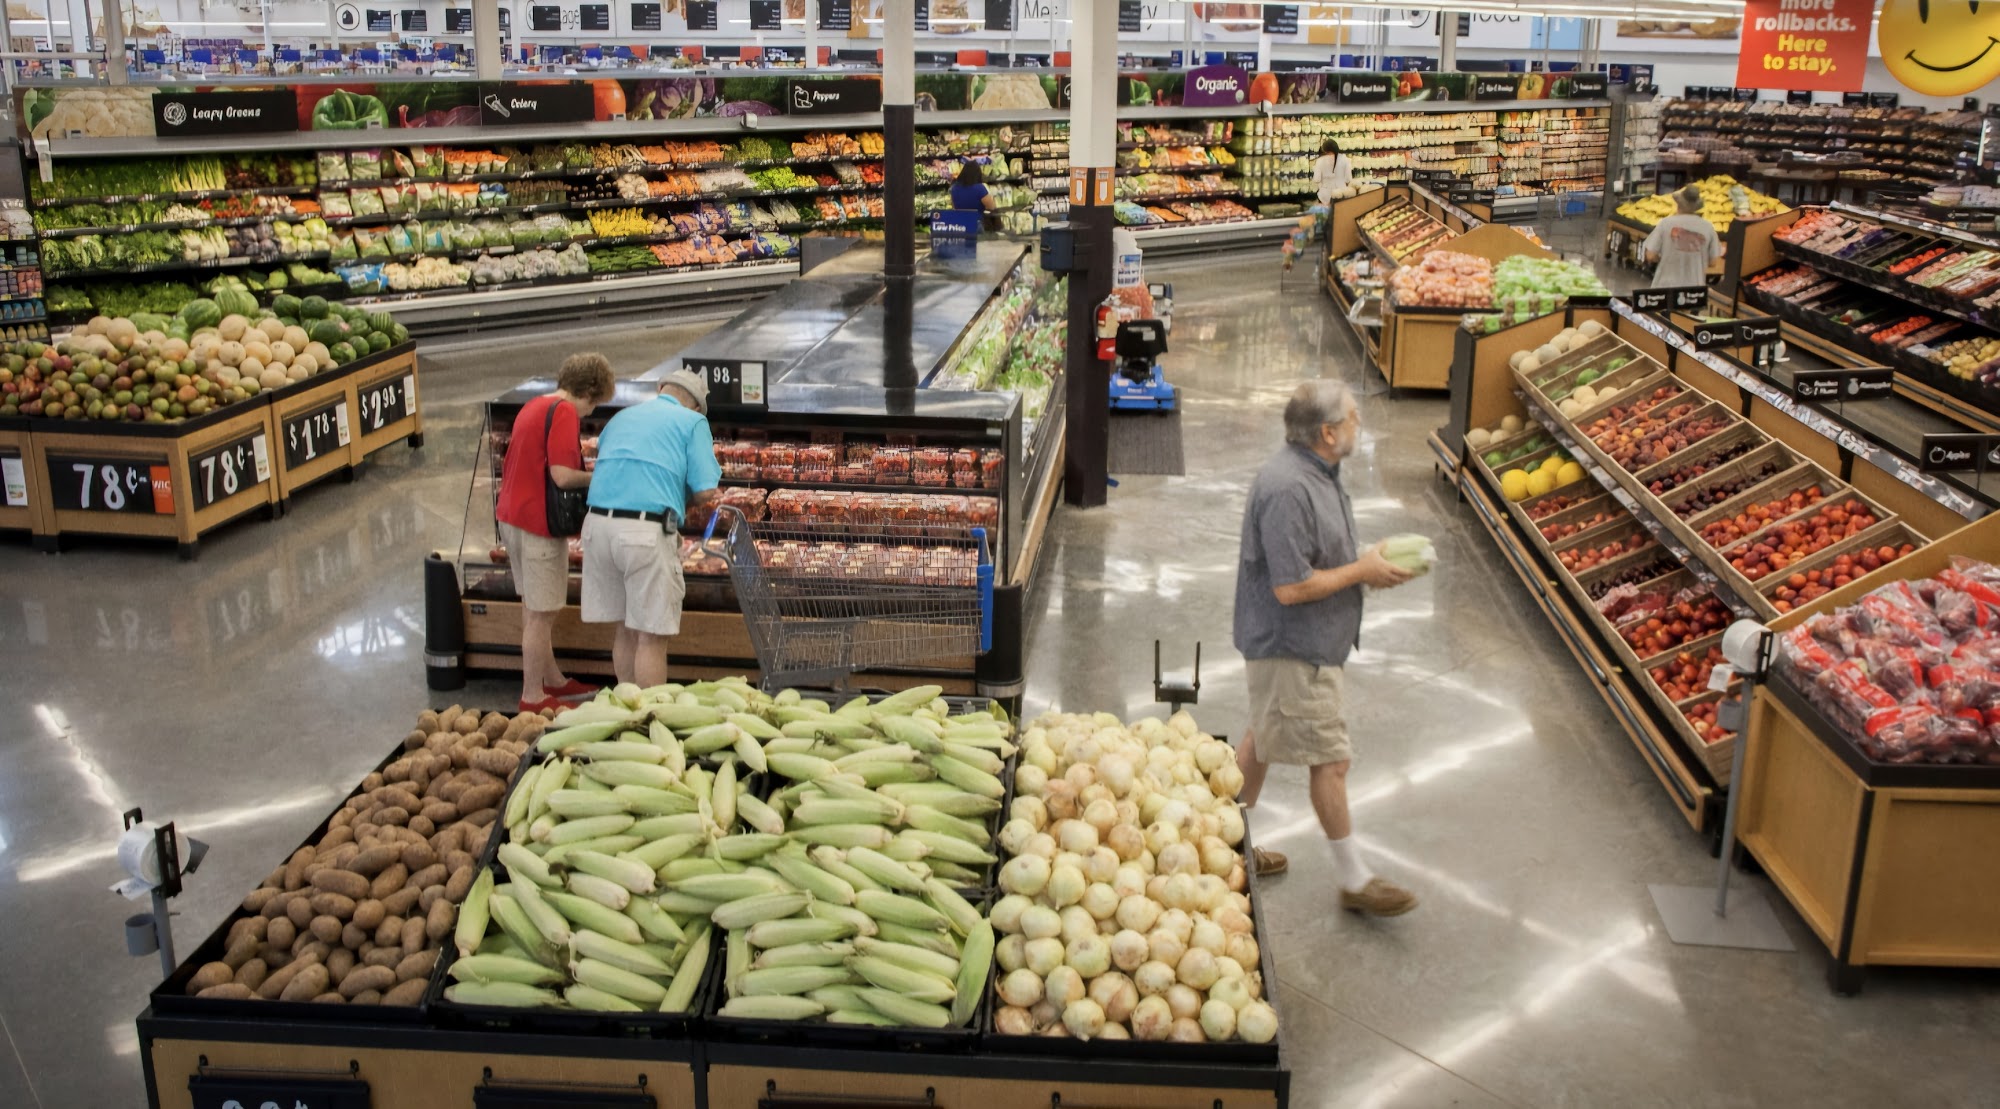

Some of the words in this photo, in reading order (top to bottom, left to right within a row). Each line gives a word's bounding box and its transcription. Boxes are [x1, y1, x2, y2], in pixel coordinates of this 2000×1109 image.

[1780, 0, 1835, 10] more
[1755, 12, 1856, 31] rollbacks.
[1778, 33, 1827, 52] Here
[1763, 53, 1785, 70] to
[1788, 54, 1837, 76] stay.
[1196, 76, 1238, 95] Organic
[813, 90, 840, 102] Peppers
[511, 98, 538, 110] Celery
[193, 107, 223, 121] Leafy
[226, 106, 261, 118] Greens
[932, 222, 948, 231] Low
[948, 223, 967, 232] Price
[713, 367, 730, 383] 98
[152, 480, 171, 489] WIC
